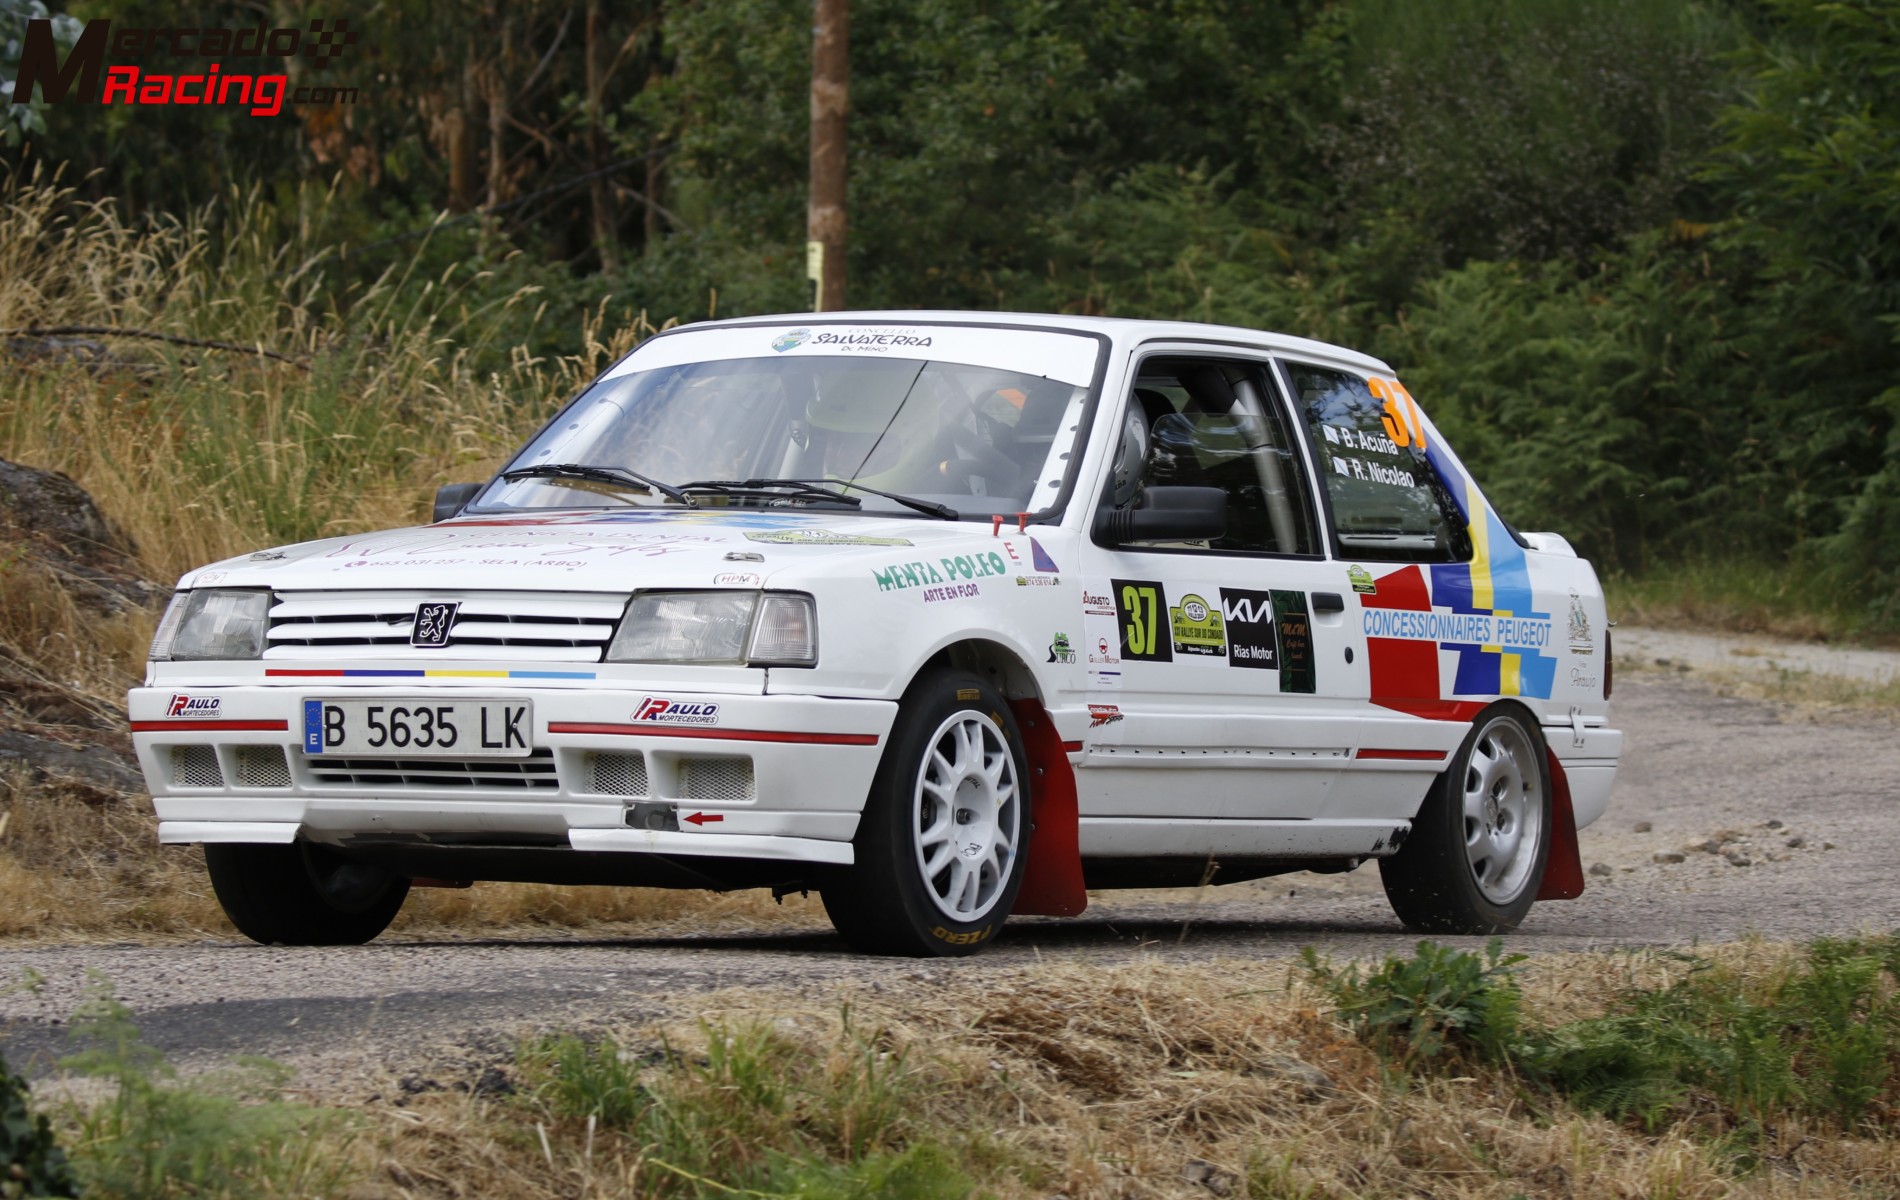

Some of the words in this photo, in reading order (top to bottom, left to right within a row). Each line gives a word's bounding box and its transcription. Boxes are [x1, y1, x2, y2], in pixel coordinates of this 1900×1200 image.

[811, 333, 932, 347] SALVATERRA
[1367, 377, 1427, 448] 37
[1340, 427, 1358, 448] B.
[1358, 430, 1399, 455] Acuña
[1351, 459, 1368, 481] R.
[1367, 461, 1415, 488] Nicolao
[1004, 542, 1019, 559] E
[478, 558, 519, 566] SELA
[523, 559, 588, 568] (ARBO)
[870, 561, 944, 592] MENTA
[940, 552, 1006, 581] POLEO
[923, 589, 946, 603] ARTE
[945, 586, 957, 600] EN
[959, 583, 980, 597] FLOR
[1083, 591, 1110, 606] AUGUSTO
[1122, 585, 1157, 655] 37
[1363, 610, 1491, 642] CONCESSIONNAIRES
[1497, 619, 1552, 646] PEUGEOT
[1233, 644, 1250, 658] Rias
[1250, 645, 1273, 660] Motor
[172, 696, 220, 716] PAULO
[641, 701, 717, 720] PAULO
[324, 705, 346, 747] B
[367, 706, 458, 748] 5635
[480, 706, 527, 749] LK
[310, 733, 318, 745] E
